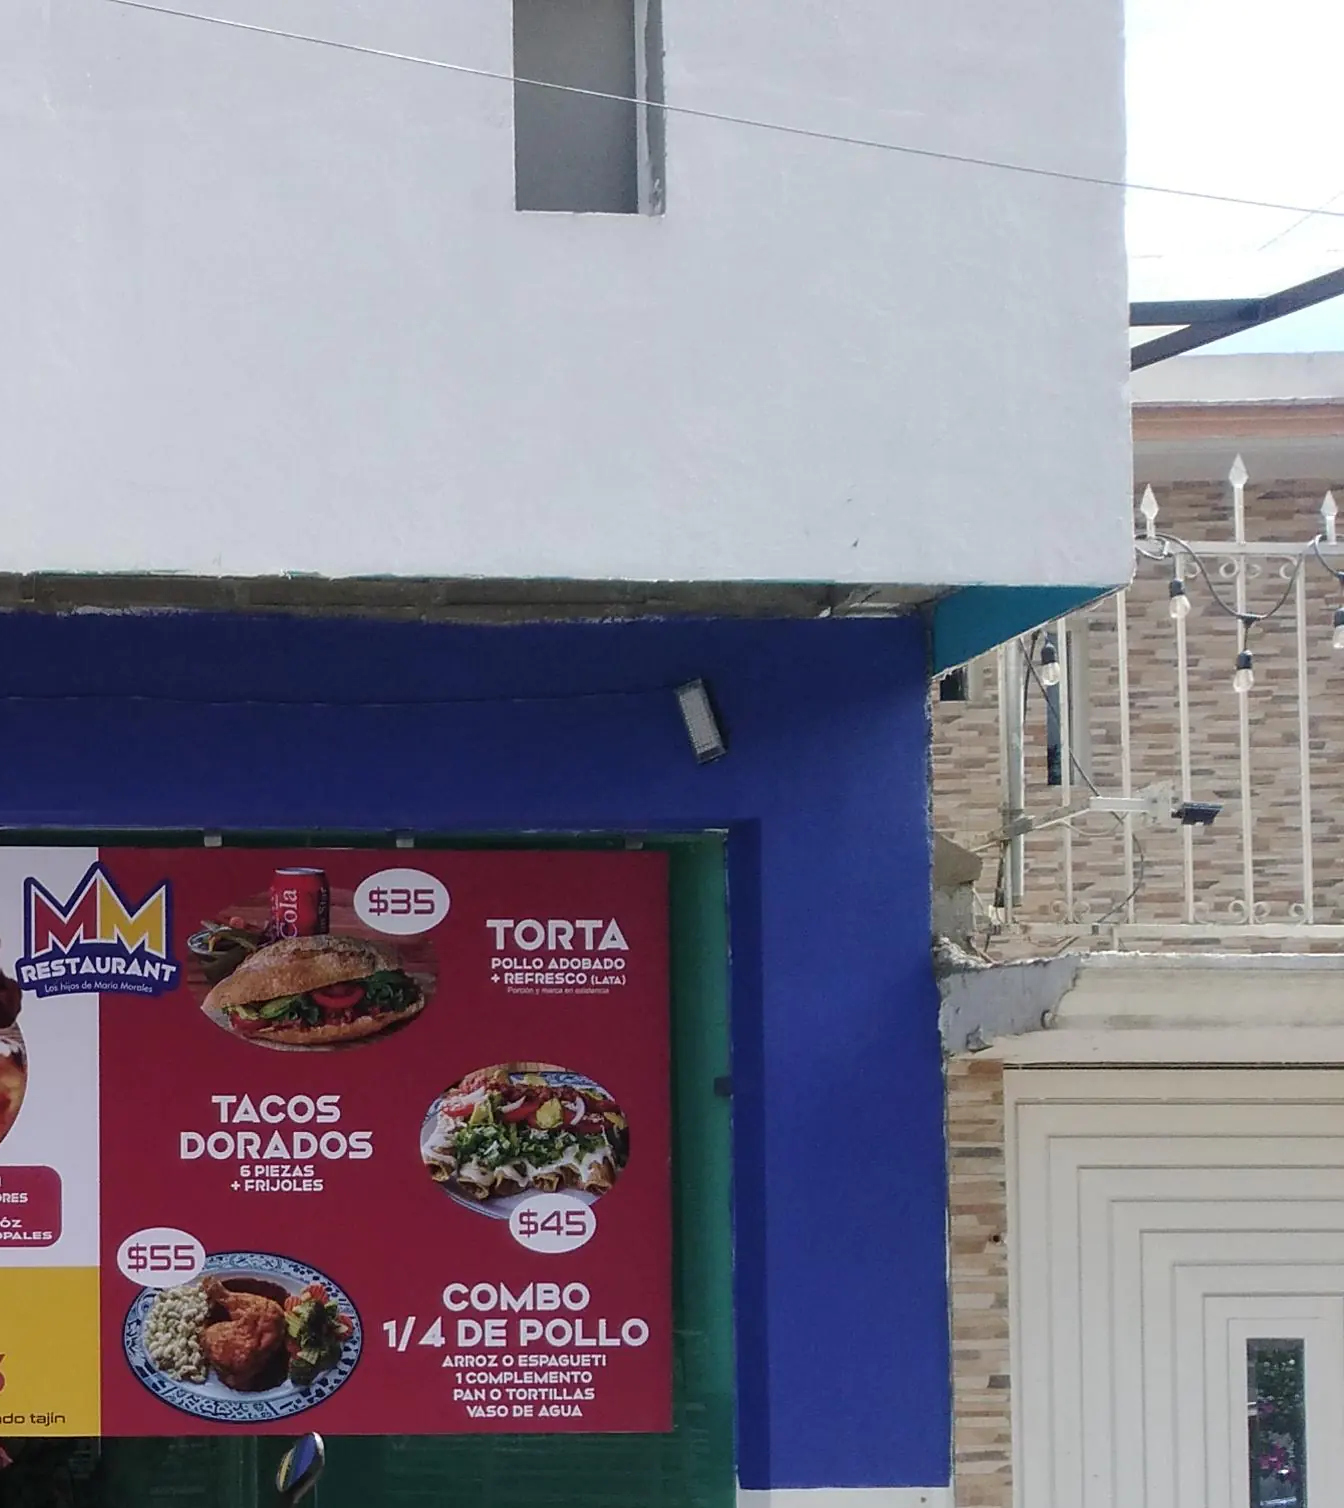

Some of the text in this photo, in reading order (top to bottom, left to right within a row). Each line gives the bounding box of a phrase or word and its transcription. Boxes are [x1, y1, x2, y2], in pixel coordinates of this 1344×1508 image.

[31, 868, 166, 960] MM
[368, 886, 435, 916] $35
[486, 917, 630, 951] TORTA
[20, 955, 176, 983] RESTAURANT
[491, 957, 626, 970] POLLO ADOBADO
[81, 980, 92, 989] de
[120, 981, 153, 993] Morales
[504, 972, 588, 985] REFRESCO
[591, 974, 627, 986] (LATA)
[211, 1094, 342, 1124] TACOS
[180, 1130, 374, 1160] DORADOS
[239, 1164, 315, 1178] 6 PIEZAS
[244, 1179, 324, 1192] FRIJOLES
[518, 1208, 587, 1238] $45
[127, 1242, 196, 1273] $55
[442, 1282, 591, 1312] COMBO
[382, 1316, 650, 1352] 1/4 DE POLLO
[441, 1354, 607, 1368] ARROZ O ESPAGUETI
[455, 1371, 593, 1385] 1 COMPLEMENTO
[453, 1388, 596, 1401] PAN O TORTILLAS
[466, 1404, 583, 1418] VASO DE AGUA
